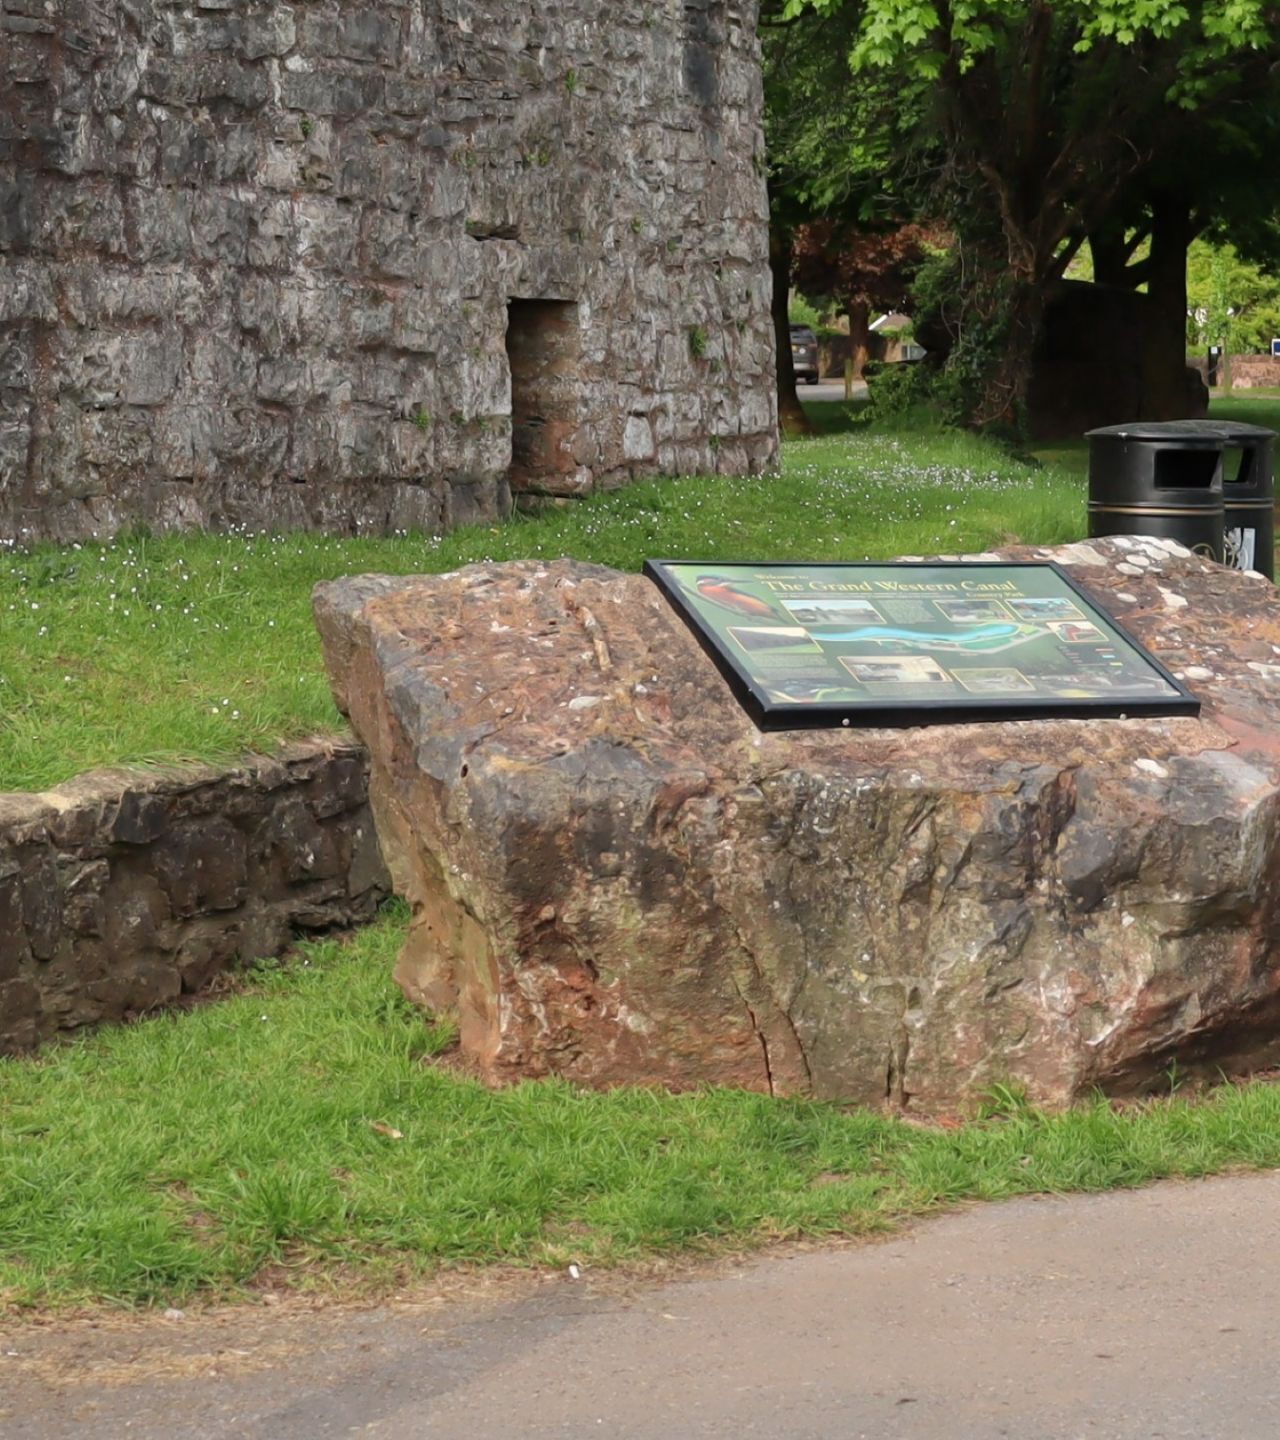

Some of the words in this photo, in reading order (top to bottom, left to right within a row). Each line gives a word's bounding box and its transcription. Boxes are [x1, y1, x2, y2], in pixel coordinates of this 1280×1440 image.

[761, 580, 804, 592] The
[809, 579, 872, 592] Grand
[875, 580, 958, 592] Western
[960, 579, 1018, 592] Canal
